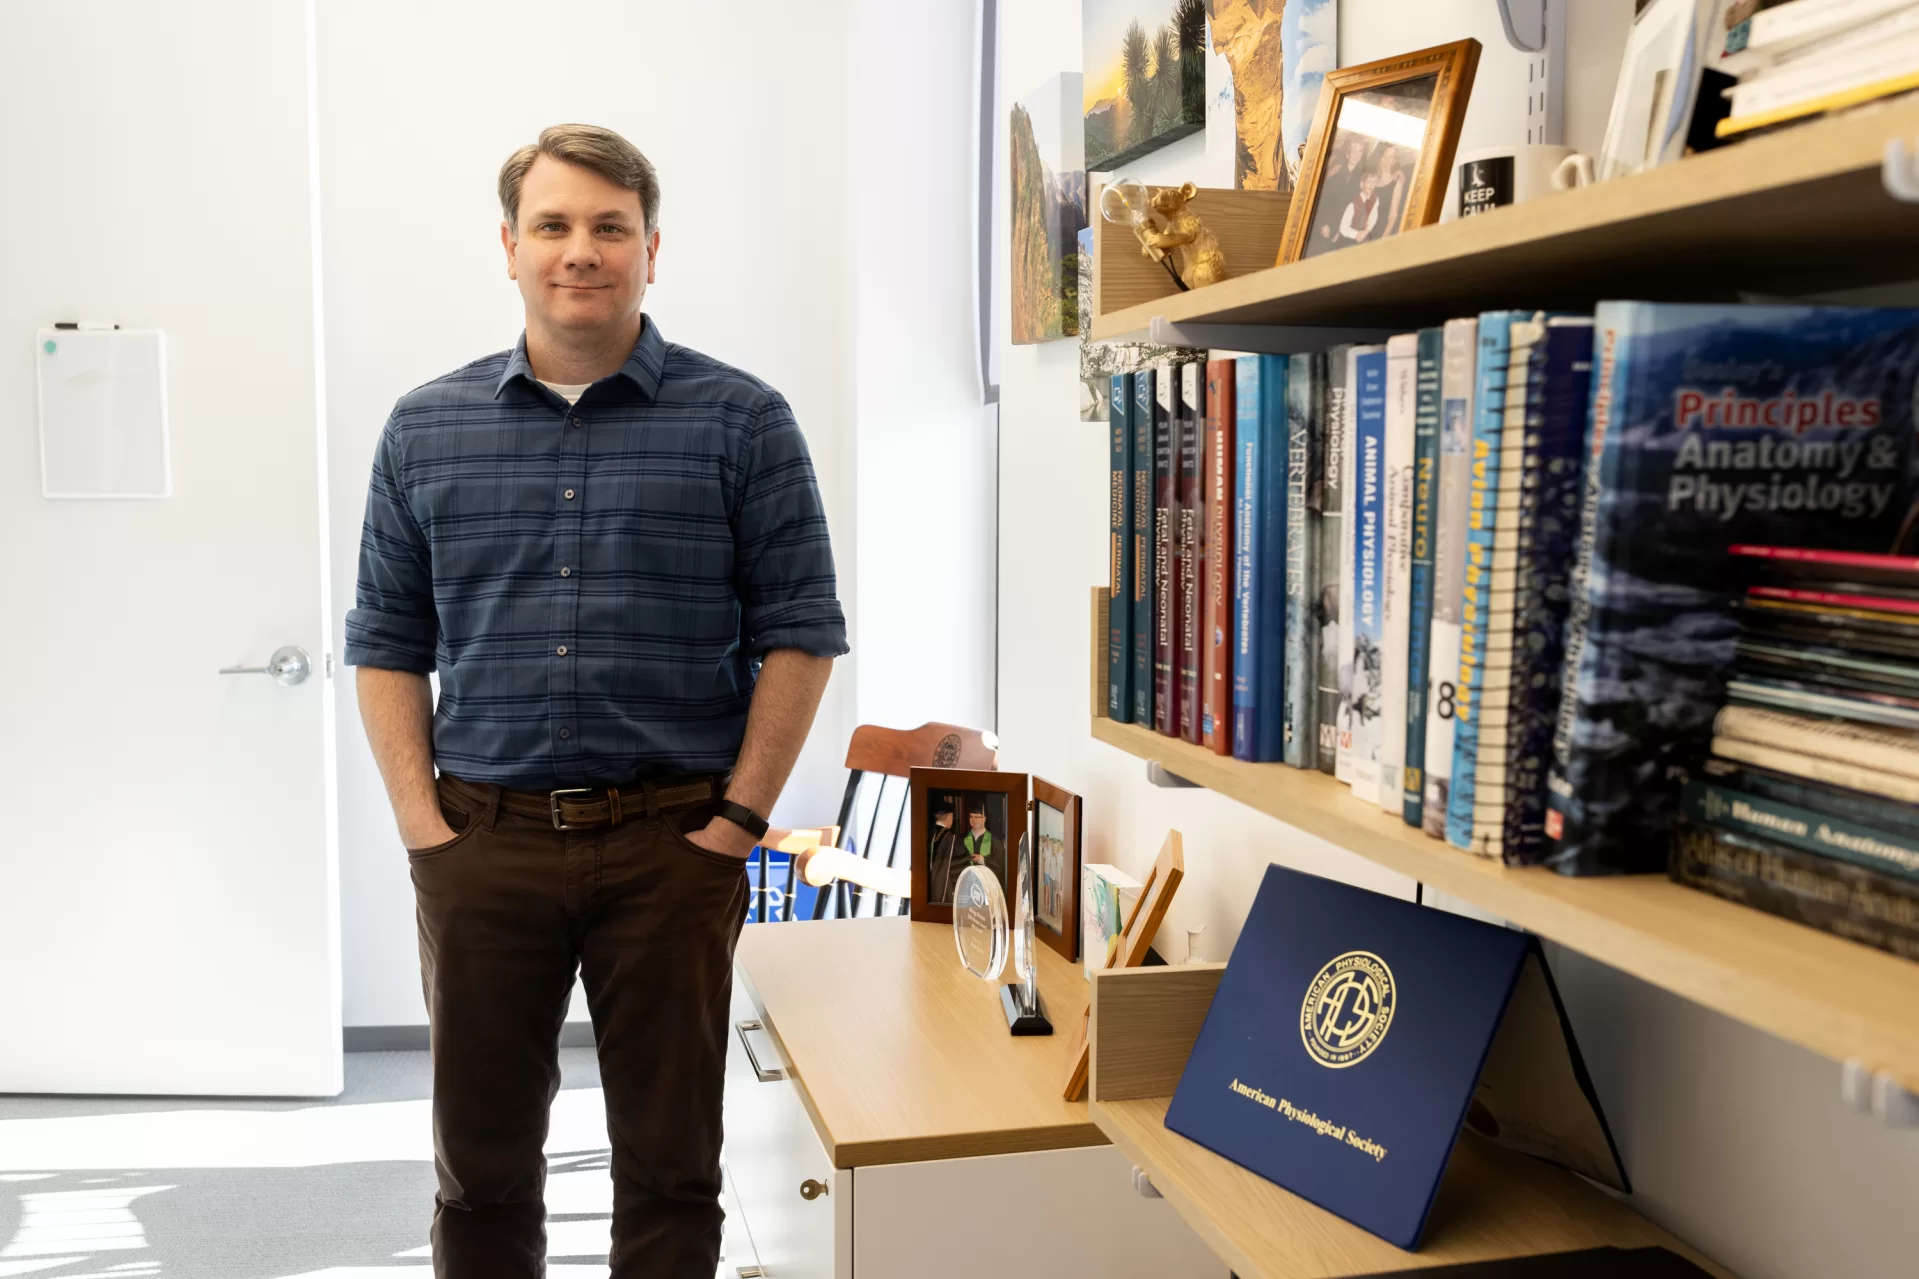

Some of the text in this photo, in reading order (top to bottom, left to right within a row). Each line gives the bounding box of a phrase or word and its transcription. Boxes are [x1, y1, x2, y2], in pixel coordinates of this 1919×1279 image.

[1464, 187, 1495, 204] KEEP
[1326, 387, 1341, 490] Physiology
[1673, 433, 1899, 479] Anatomy &
[1675, 388, 1882, 436] Principles
[1216, 430, 1224, 501] HUMAN
[1363, 435, 1377, 505] ANIMAL
[1388, 466, 1400, 528] Animal
[1414, 457, 1433, 558] Neuro
[1667, 472, 1896, 522] Physiology
[1240, 442, 1253, 655] Functional Anatomy of the Vertebrates
[1287, 428, 1308, 596] VERTEBRATES
[1160, 507, 1169, 646] Fetal and Neonatal
[1184, 509, 1195, 651] Fetal and Neonatal
[1361, 511, 1376, 627] PHYSIOLOGY
[1456, 439, 1490, 721] Avian Physiology
[1411, 567, 1428, 685] science
[1438, 682, 1456, 720] 8
[1732, 800, 1808, 837] Human
[1305, 956, 1391, 1054] AMERICAN PHYSIOLOGICAL SOCIETY
[1228, 1078, 1388, 1162] American Physiological Society
